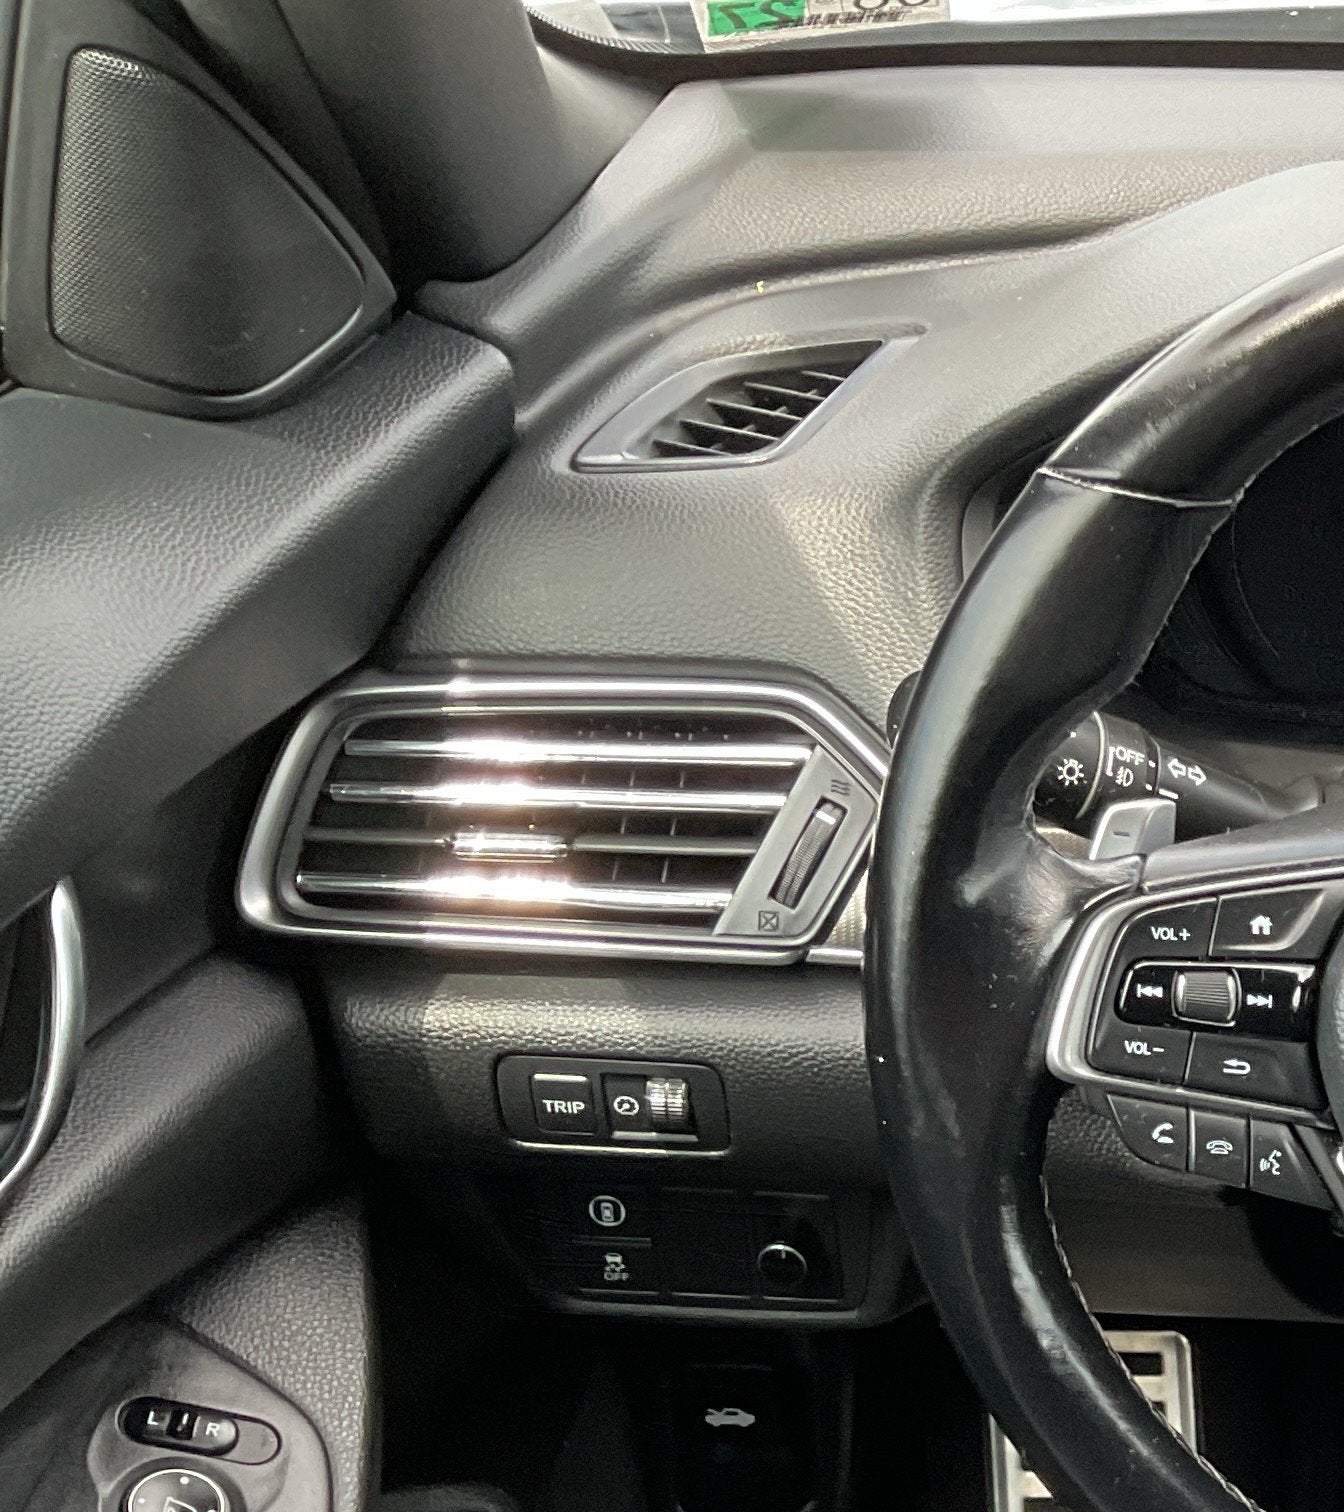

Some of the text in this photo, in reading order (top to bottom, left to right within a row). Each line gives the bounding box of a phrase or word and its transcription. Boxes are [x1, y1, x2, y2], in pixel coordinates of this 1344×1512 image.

[1115, 746, 1146, 766] OFF
[542, 1098, 586, 1116] TRIP
[147, 1410, 159, 1426] L
[205, 1421, 221, 1437] R
